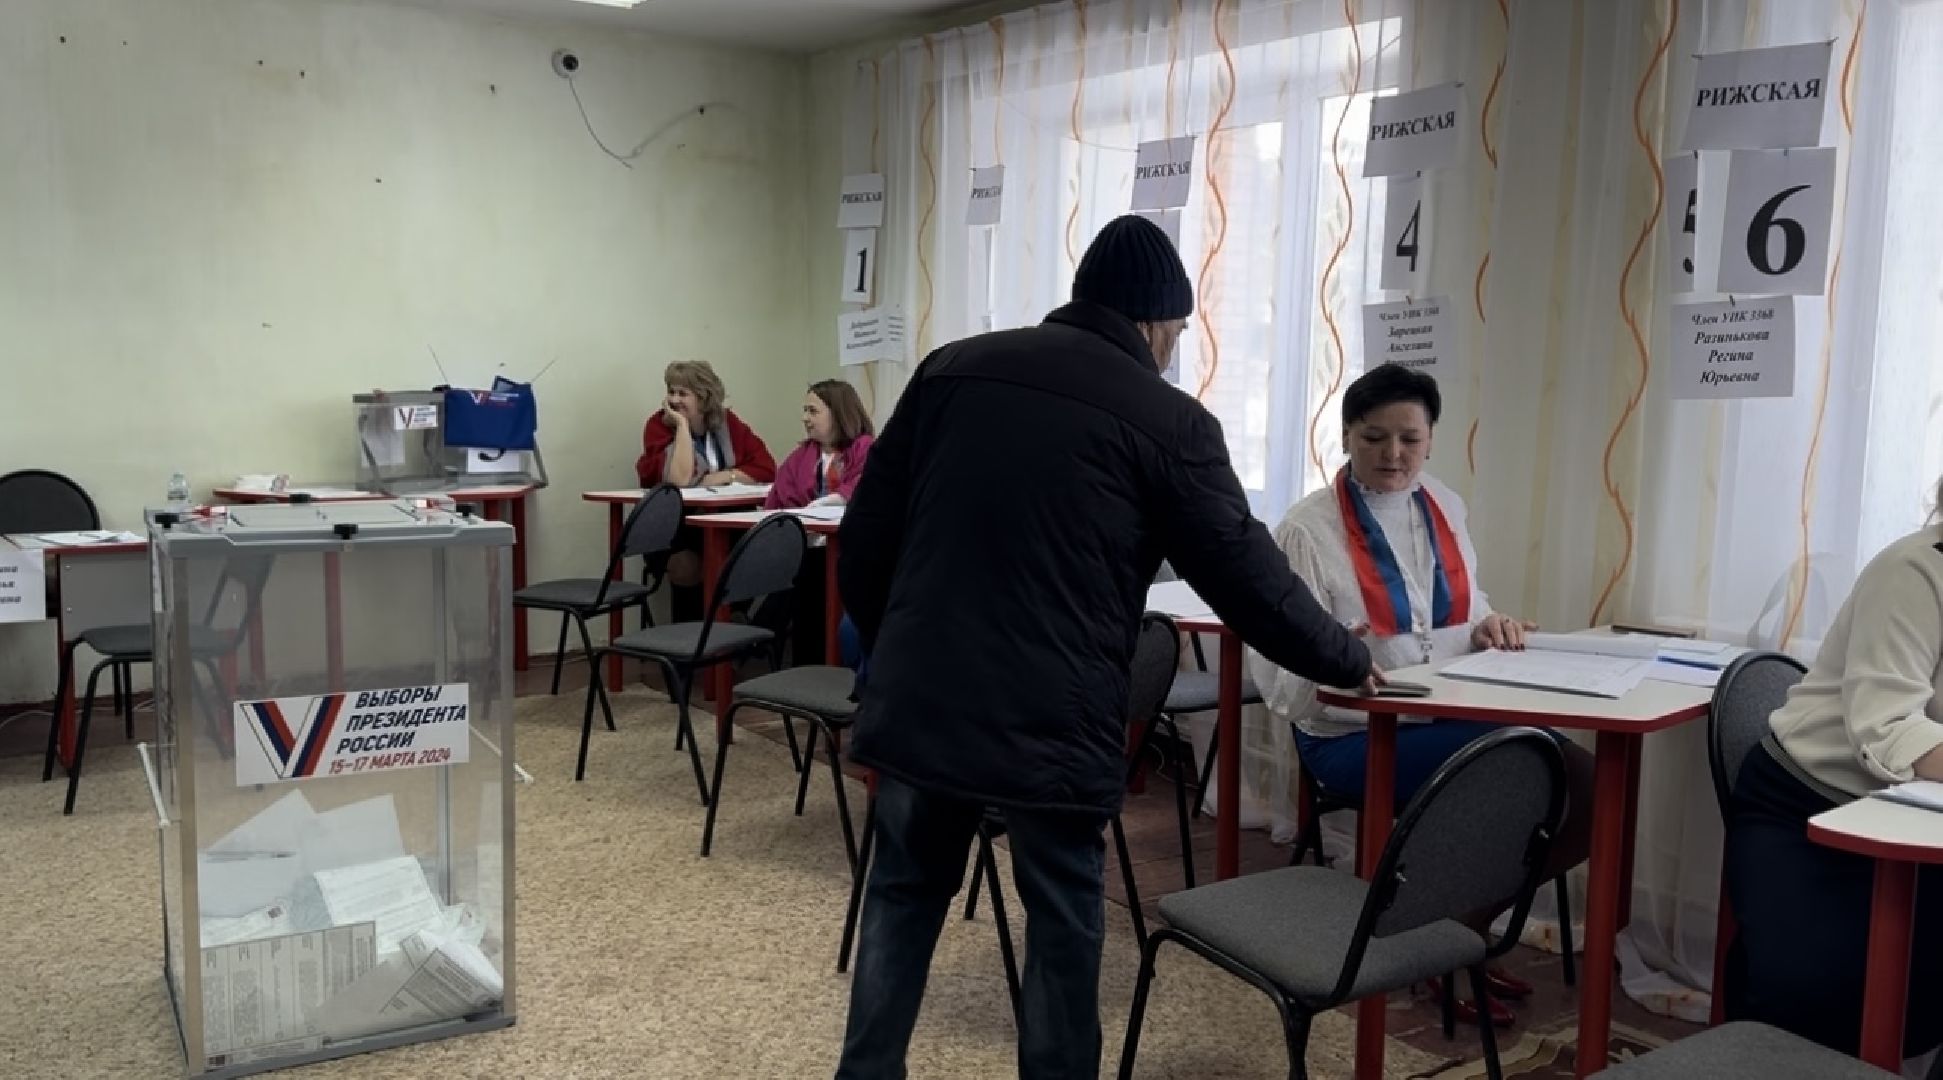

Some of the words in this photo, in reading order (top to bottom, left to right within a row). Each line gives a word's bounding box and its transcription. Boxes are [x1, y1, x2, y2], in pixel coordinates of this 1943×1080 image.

[1697, 78, 1821, 107] РИЖСКАЯ
[1370, 111, 1456, 140] РИЖСКАЯ
[1136, 161, 1192, 180] РИЖСКАЯ
[1396, 199, 1421, 272] 4
[1746, 184, 1812, 275] 6
[854, 247, 868, 293] 1
[1722, 310, 1749, 323] УПК
[1694, 331, 1770, 345] Разинькова
[1708, 349, 1755, 363] Регина
[1700, 370, 1760, 386] Юрьевна
[354, 685, 443, 710] ВЫБОРЫ
[345, 703, 468, 733] ПРЕЗИДЕНТА
[336, 729, 416, 755] РОССИИ
[368, 750, 417, 770] МАРТА
[416, 746, 451, 764] 2024
